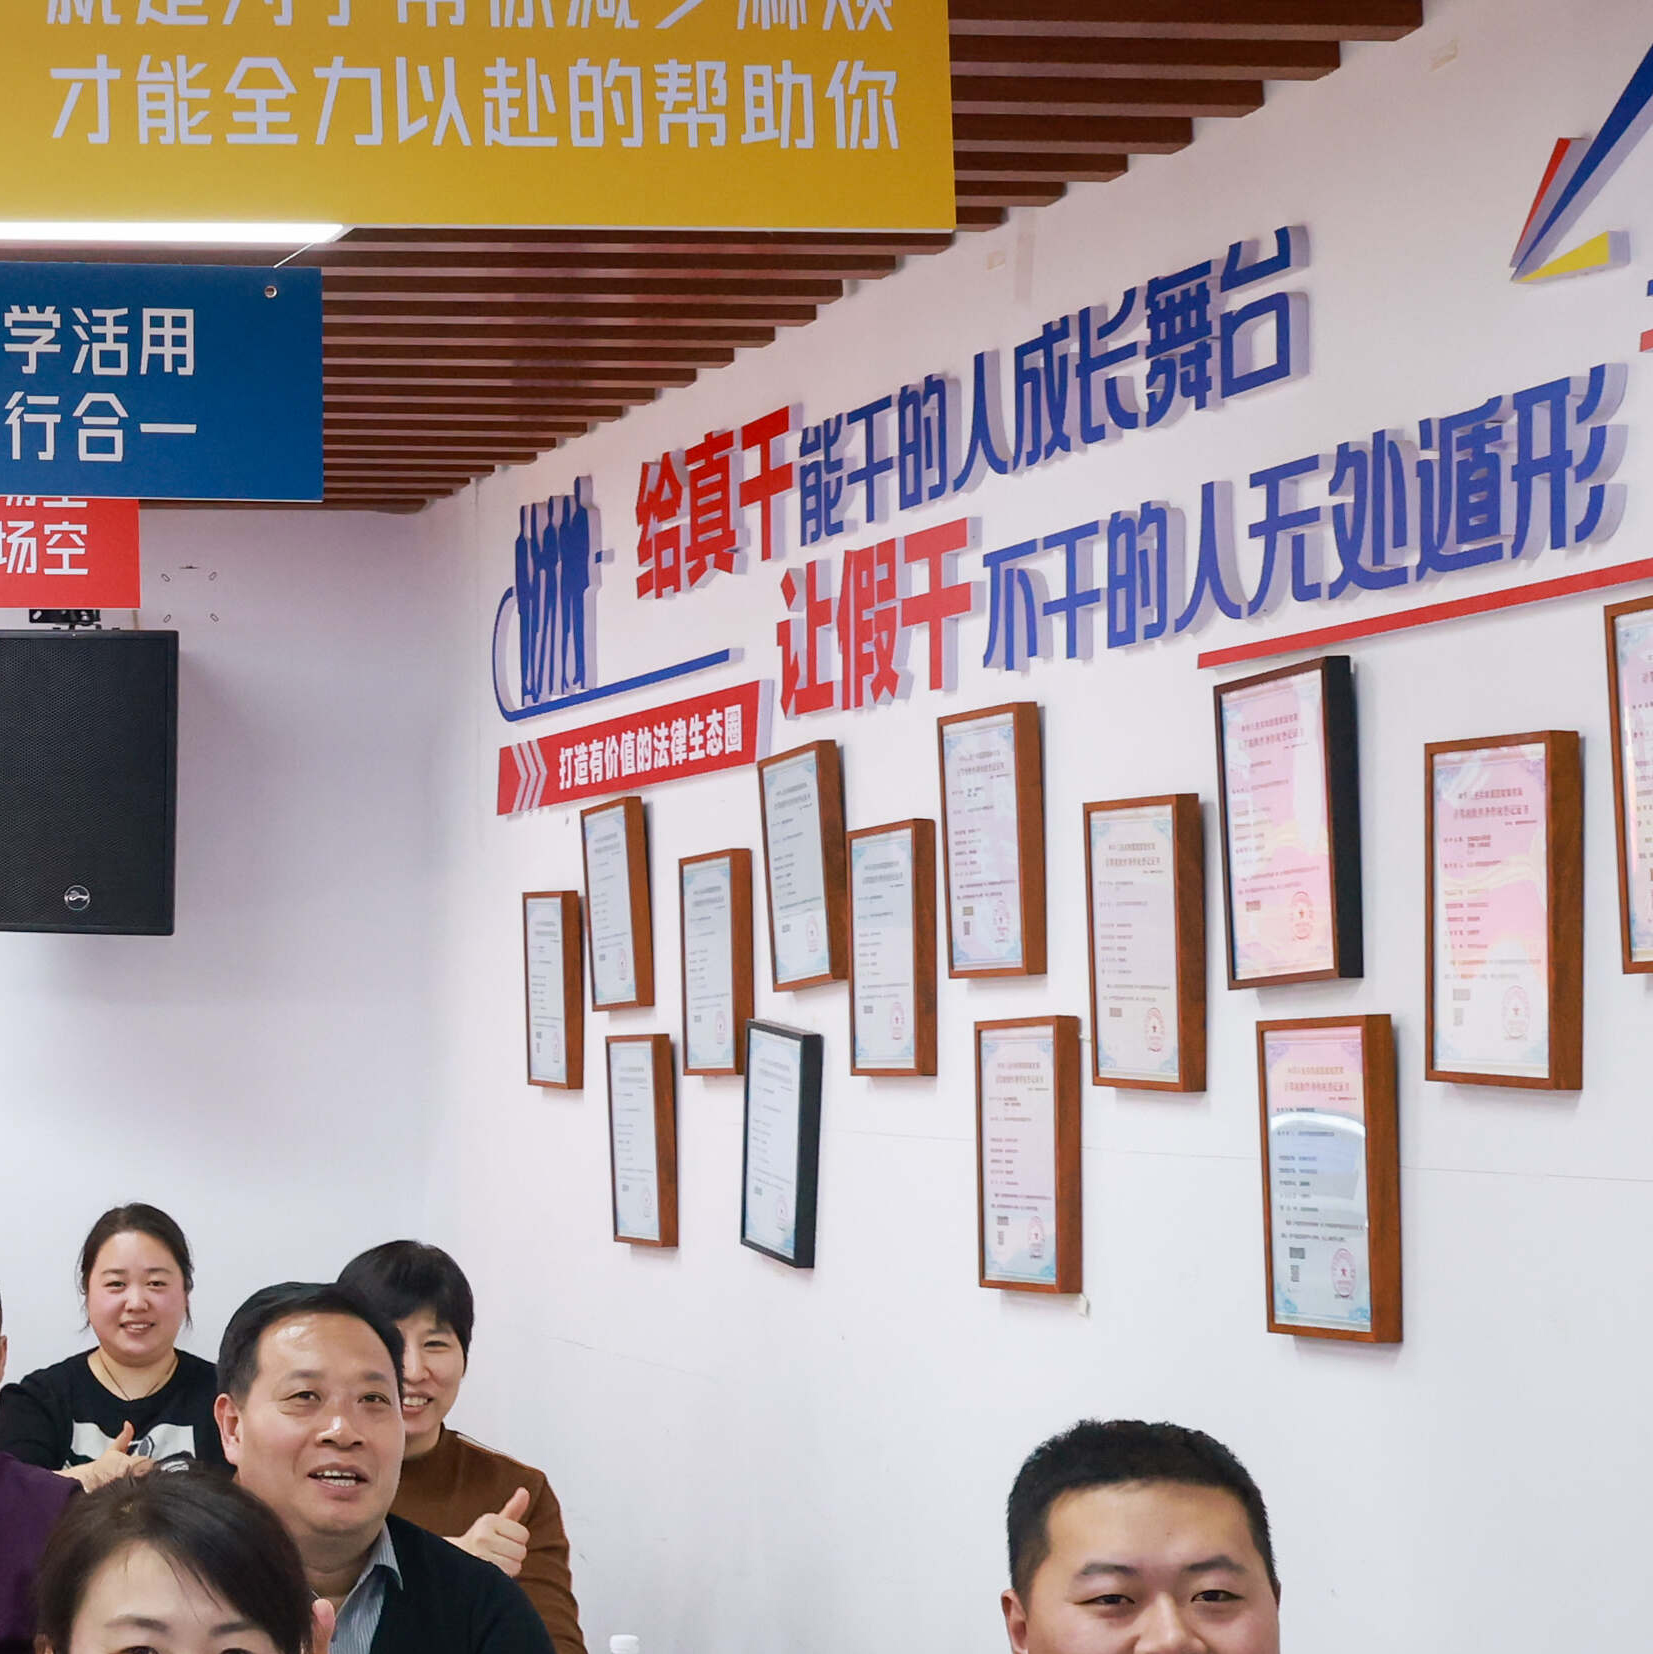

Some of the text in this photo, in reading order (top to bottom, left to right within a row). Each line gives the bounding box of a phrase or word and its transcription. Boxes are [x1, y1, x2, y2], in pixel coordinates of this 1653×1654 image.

[634, 225, 1297, 600] 给真干能干的人成长舞台
[776, 363, 1607, 721] 让假干不干的人无处遁形
[558, 704, 743, 790] 打造有价值的法律生态圈
